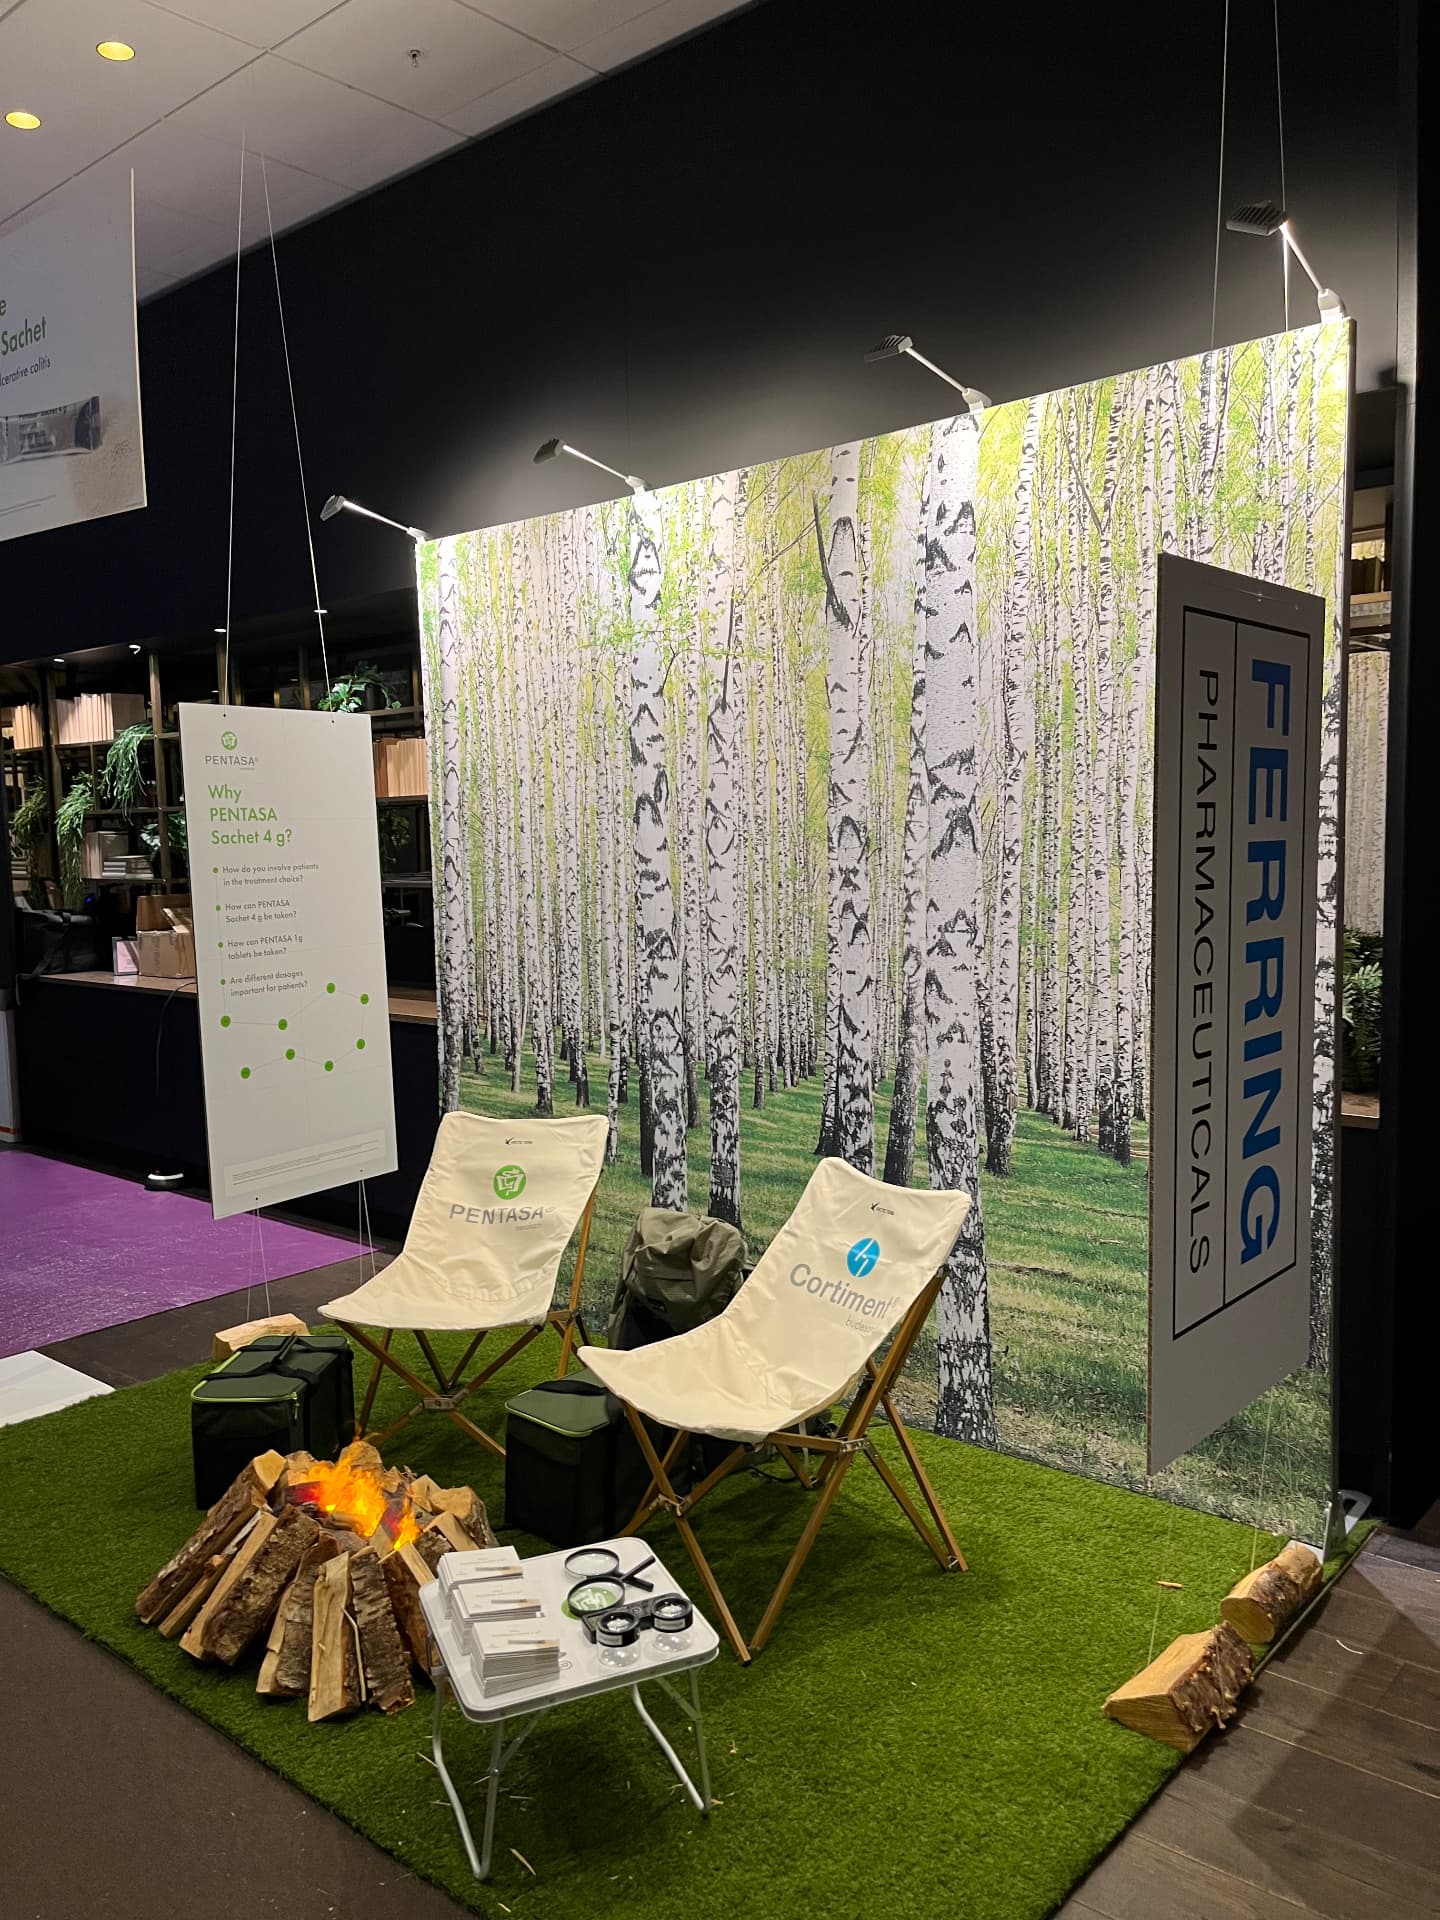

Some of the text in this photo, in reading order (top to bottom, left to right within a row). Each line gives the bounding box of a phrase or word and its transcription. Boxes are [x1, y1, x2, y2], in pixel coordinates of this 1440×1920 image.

[1, 315, 47, 356] Sachet
[29, 355, 51, 374] colitis
[207, 783, 242, 804] Why
[210, 807, 279, 822] PENTASA
[211, 828, 293, 848] Sachet 4 g?
[222, 862, 319, 875] How do you involve patients
[223, 874, 304, 886] in the treatment choice?
[225, 899, 290, 911] How can PENTASA
[225, 914, 250, 923] Sachet
[263, 912, 273, 920] be
[274, 910, 297, 920] taken?
[227, 939, 244, 948] How
[260, 935, 293, 945] PENTASA
[294, 934, 304, 943] 1g
[228, 947, 287, 960] tablets be taken?
[1239, 659, 1291, 1265] FERRING
[230, 970, 303, 985] Are different dosages
[1189, 669, 1219, 1274] PHARMACEUTICALS
[230, 980, 308, 997] important for patients?
